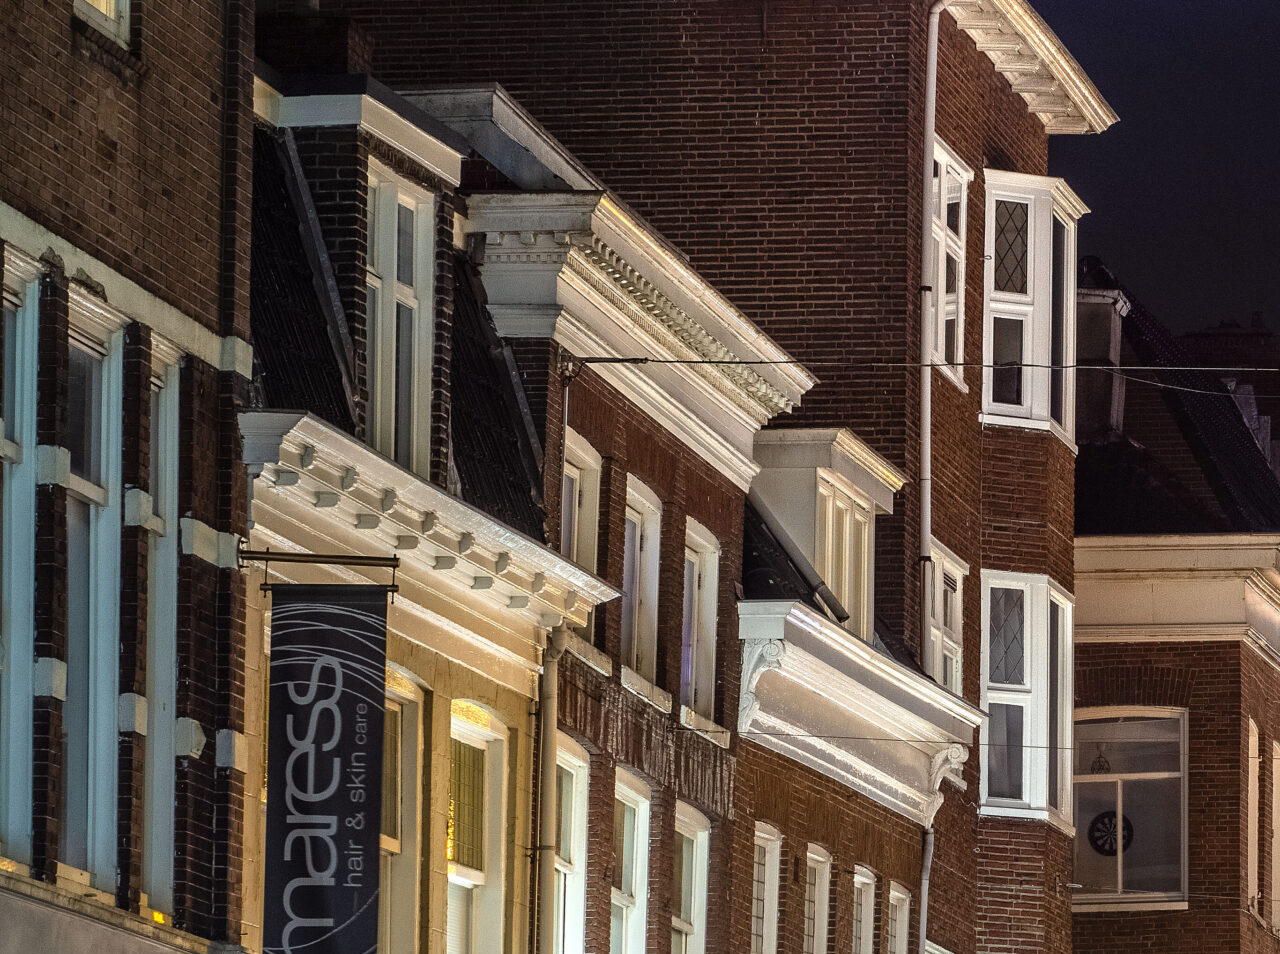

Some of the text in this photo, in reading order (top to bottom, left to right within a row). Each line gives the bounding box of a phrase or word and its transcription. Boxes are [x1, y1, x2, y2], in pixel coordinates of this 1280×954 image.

[343, 702, 369, 888] hair & skin care
